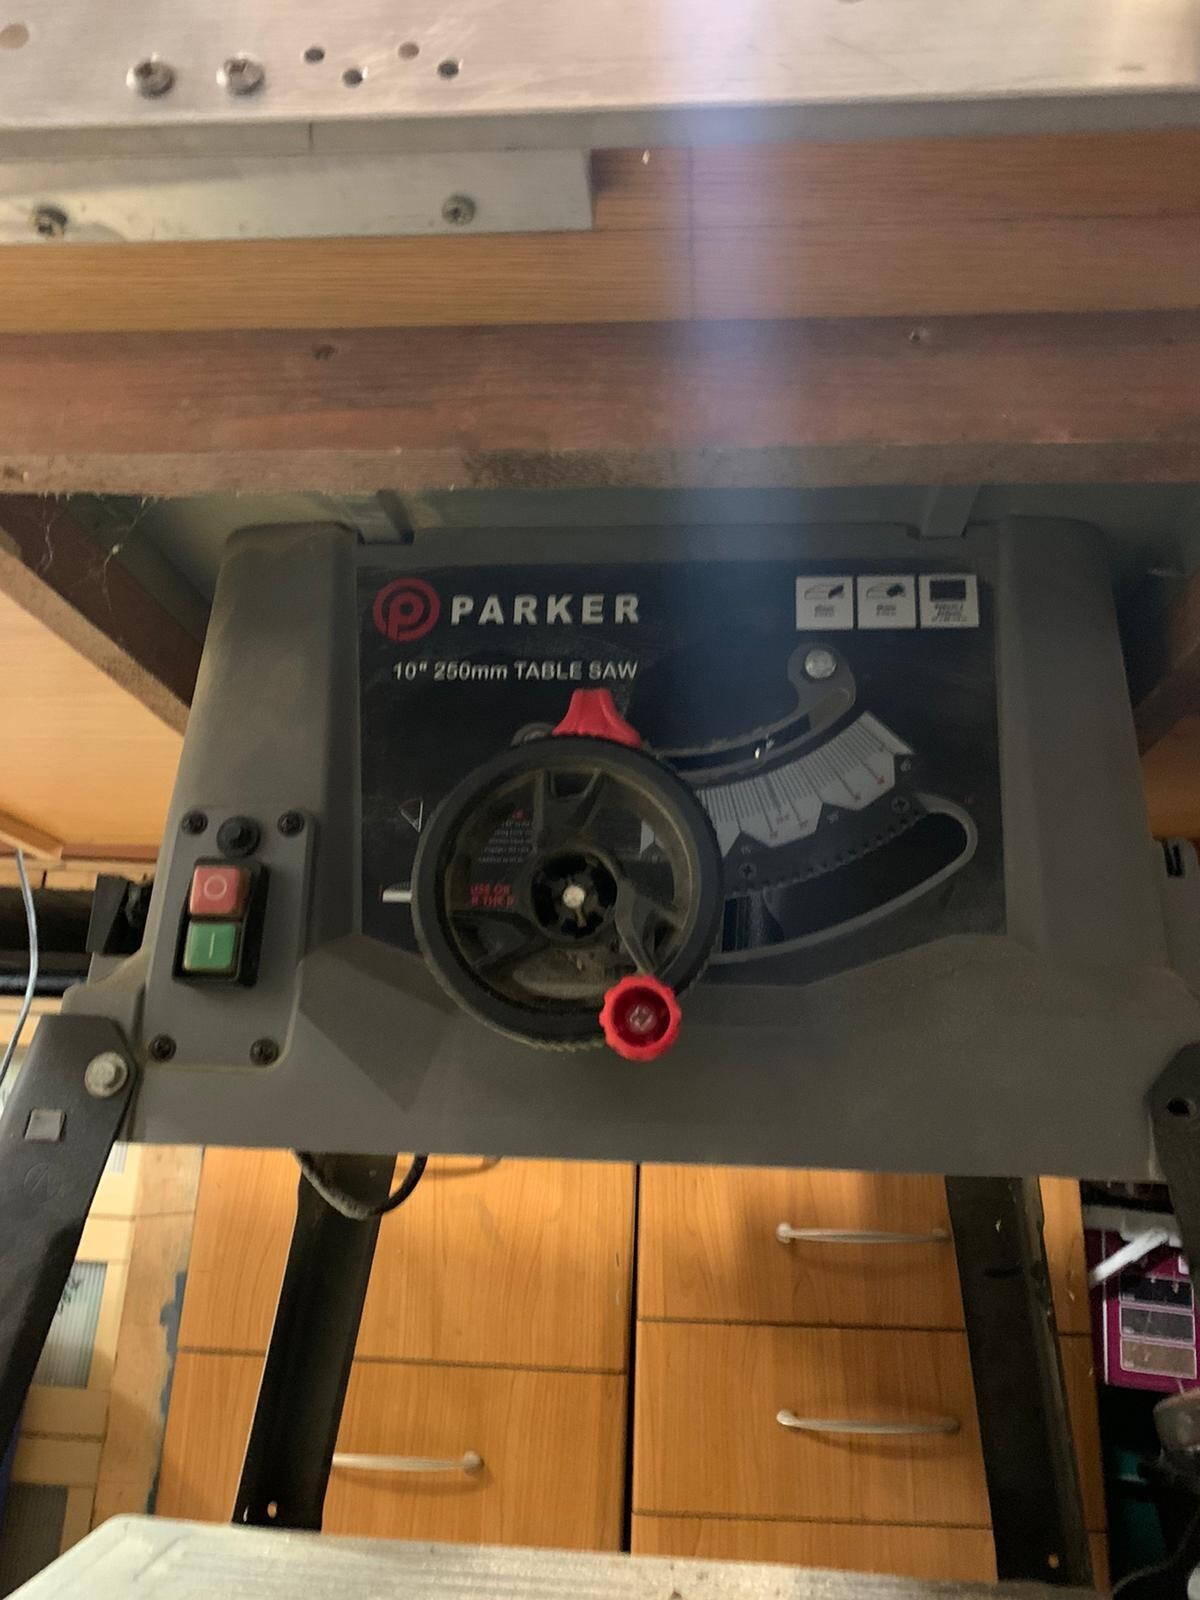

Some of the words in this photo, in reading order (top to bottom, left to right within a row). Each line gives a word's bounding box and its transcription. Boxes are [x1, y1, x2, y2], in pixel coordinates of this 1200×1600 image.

[450, 593, 640, 626] PARKER
[393, 661, 428, 681] 10"
[433, 661, 508, 681] 250mm
[514, 660, 582, 680] TABLE
[588, 659, 639, 680] SAW
